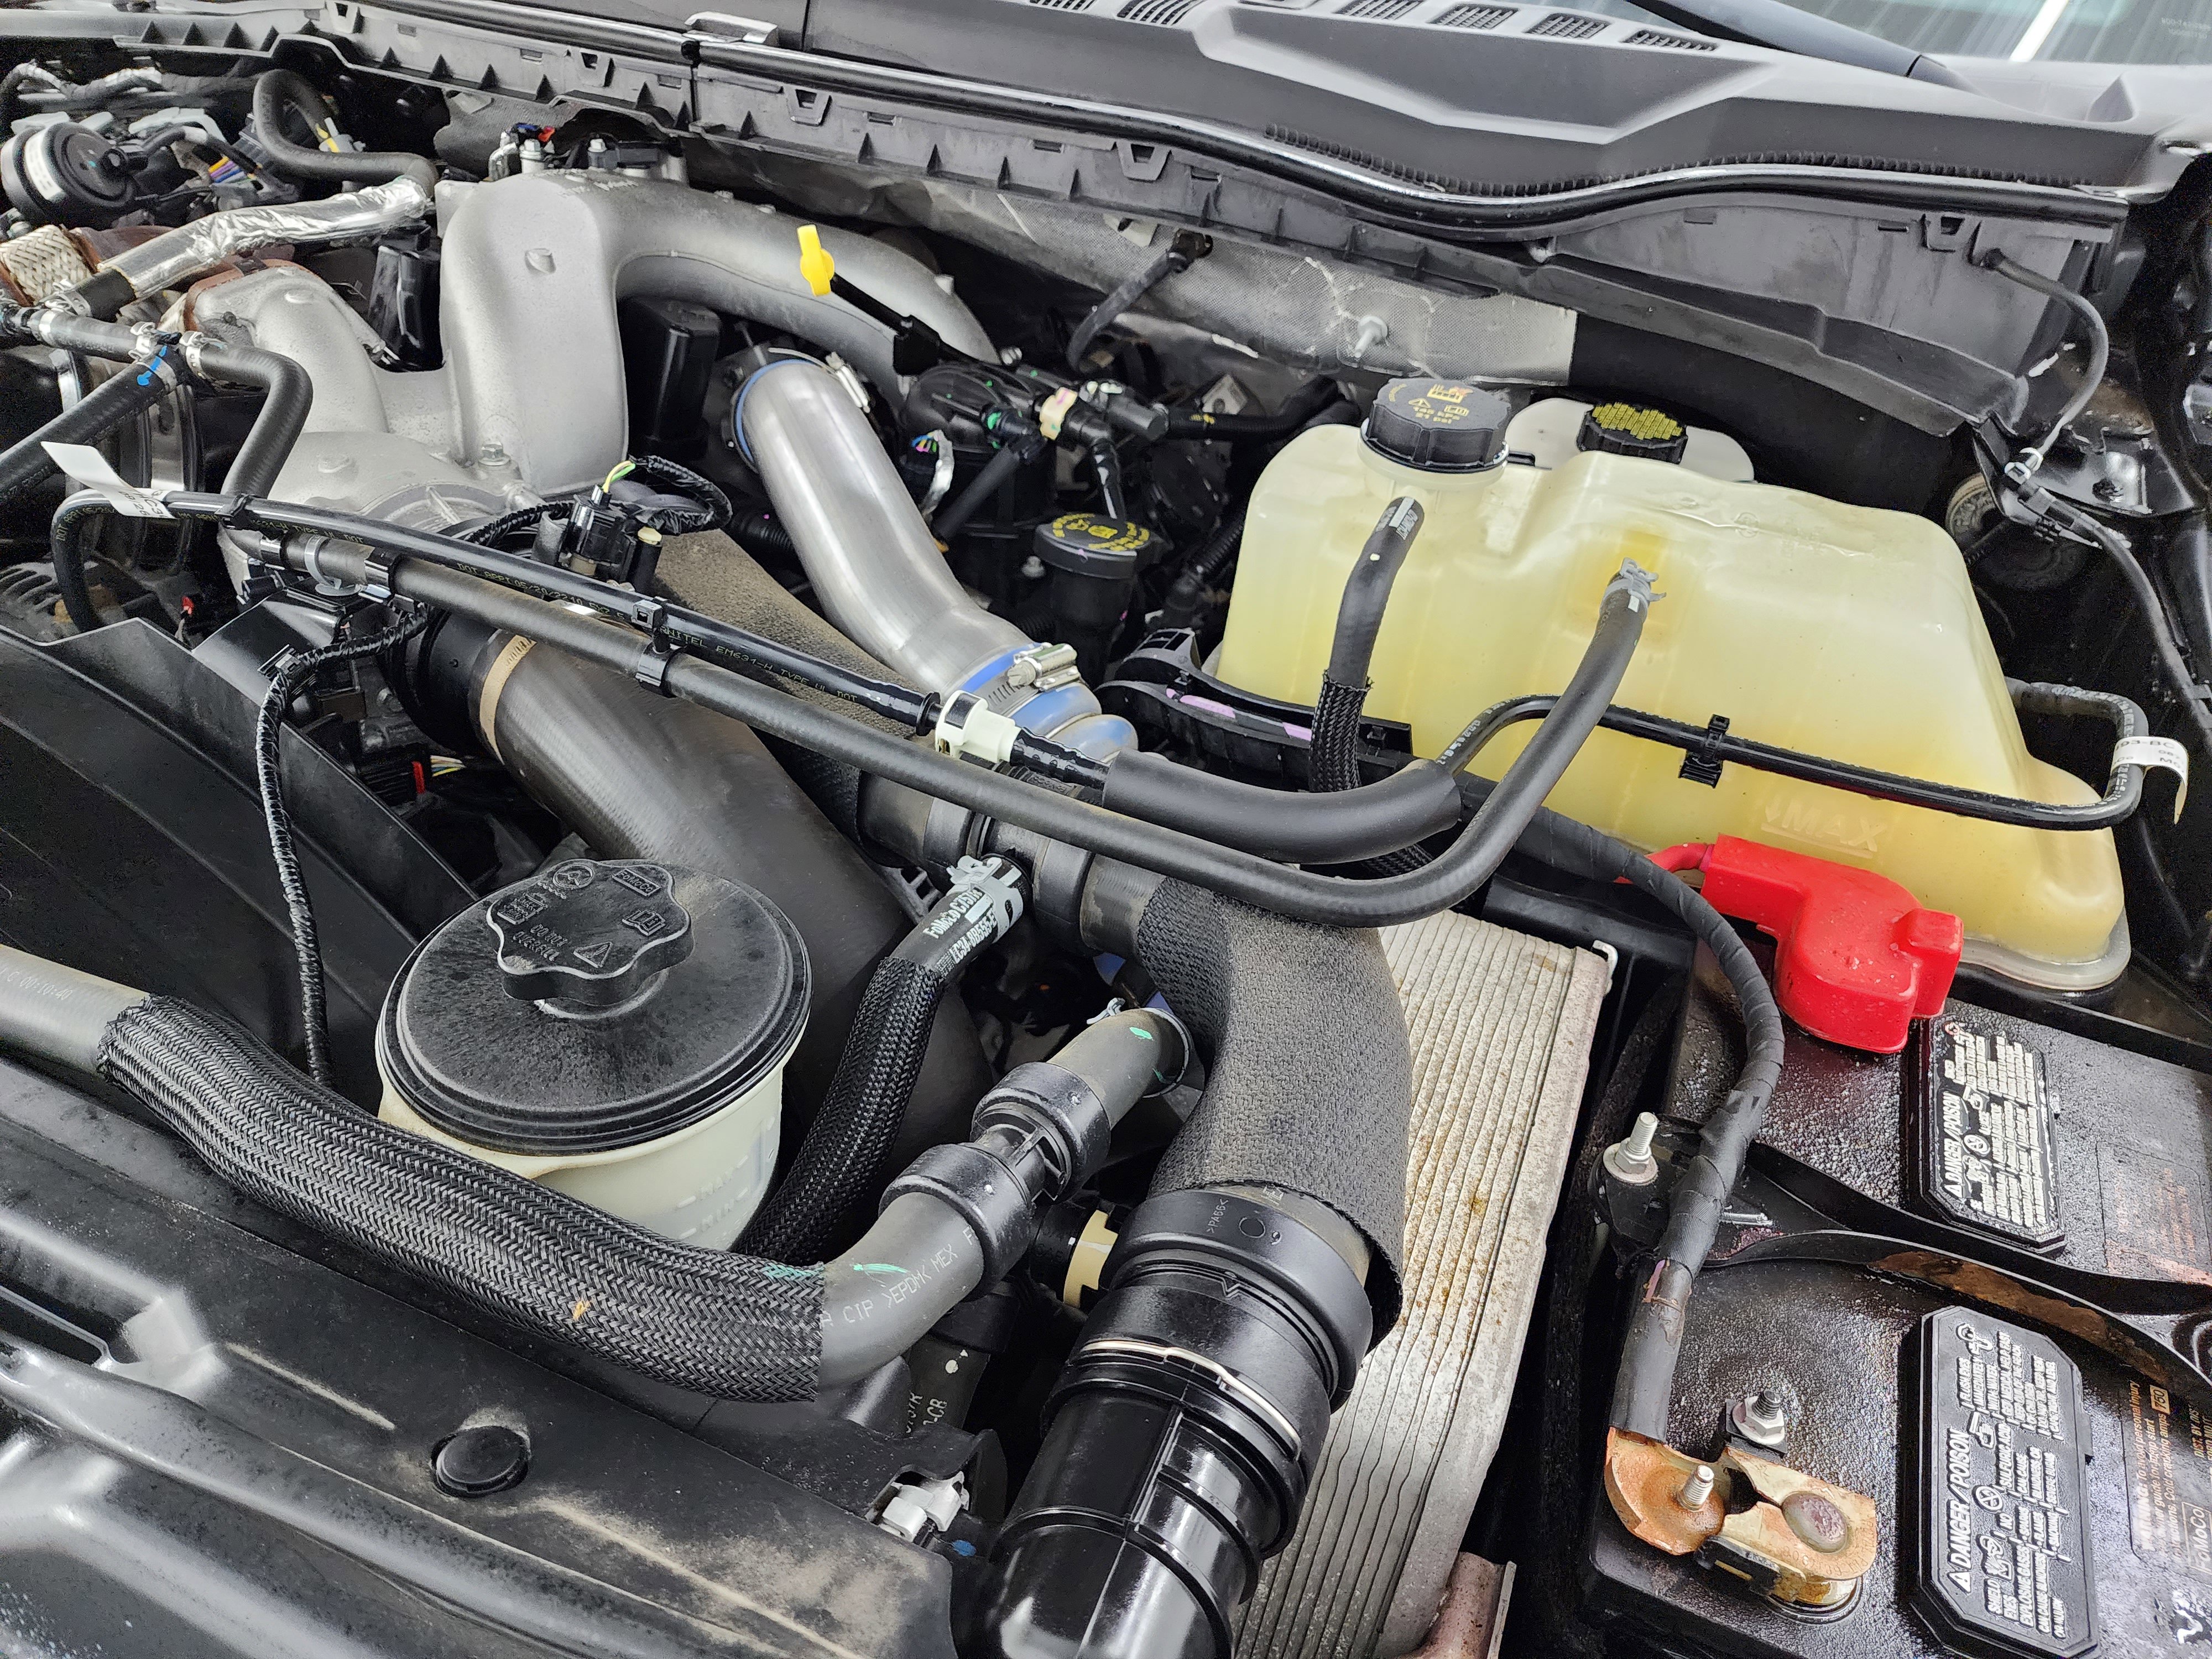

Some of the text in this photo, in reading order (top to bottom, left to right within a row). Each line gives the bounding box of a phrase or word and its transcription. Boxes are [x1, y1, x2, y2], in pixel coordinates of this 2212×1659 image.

[780, 669, 810, 686] TYPE
[619, 871, 654, 893] FoMoCo
[930, 1243, 958, 1272] MEX
[1959, 1375, 1971, 1400] FLUSH
[2129, 1379, 2142, 1405] injury
[2152, 1389, 2167, 1409] 750
[2130, 1405, 2146, 1443] personal
[2145, 1417, 2156, 1441] start
[2158, 1412, 2171, 1438] amps
[1997, 1422, 2013, 1487] SULFURIC ACID
[2016, 1476, 2028, 1493] CAN
[2163, 1477, 2176, 1500] Cold
[1999, 1512, 2013, 1529] NO
[2018, 1505, 2030, 1536] SPARKS
[2032, 1510, 2044, 1541] FLAMES
[2047, 1511, 2060, 1546] SMOKING
[1986, 1578, 2002, 1614] SHIELD
[2016, 1545, 2034, 1626] EXPLOSIVE GASES
[2034, 1551, 2051, 1632] CAN CAUSE BLINDNESS
[2002, 1594, 2018, 1620] EYES
